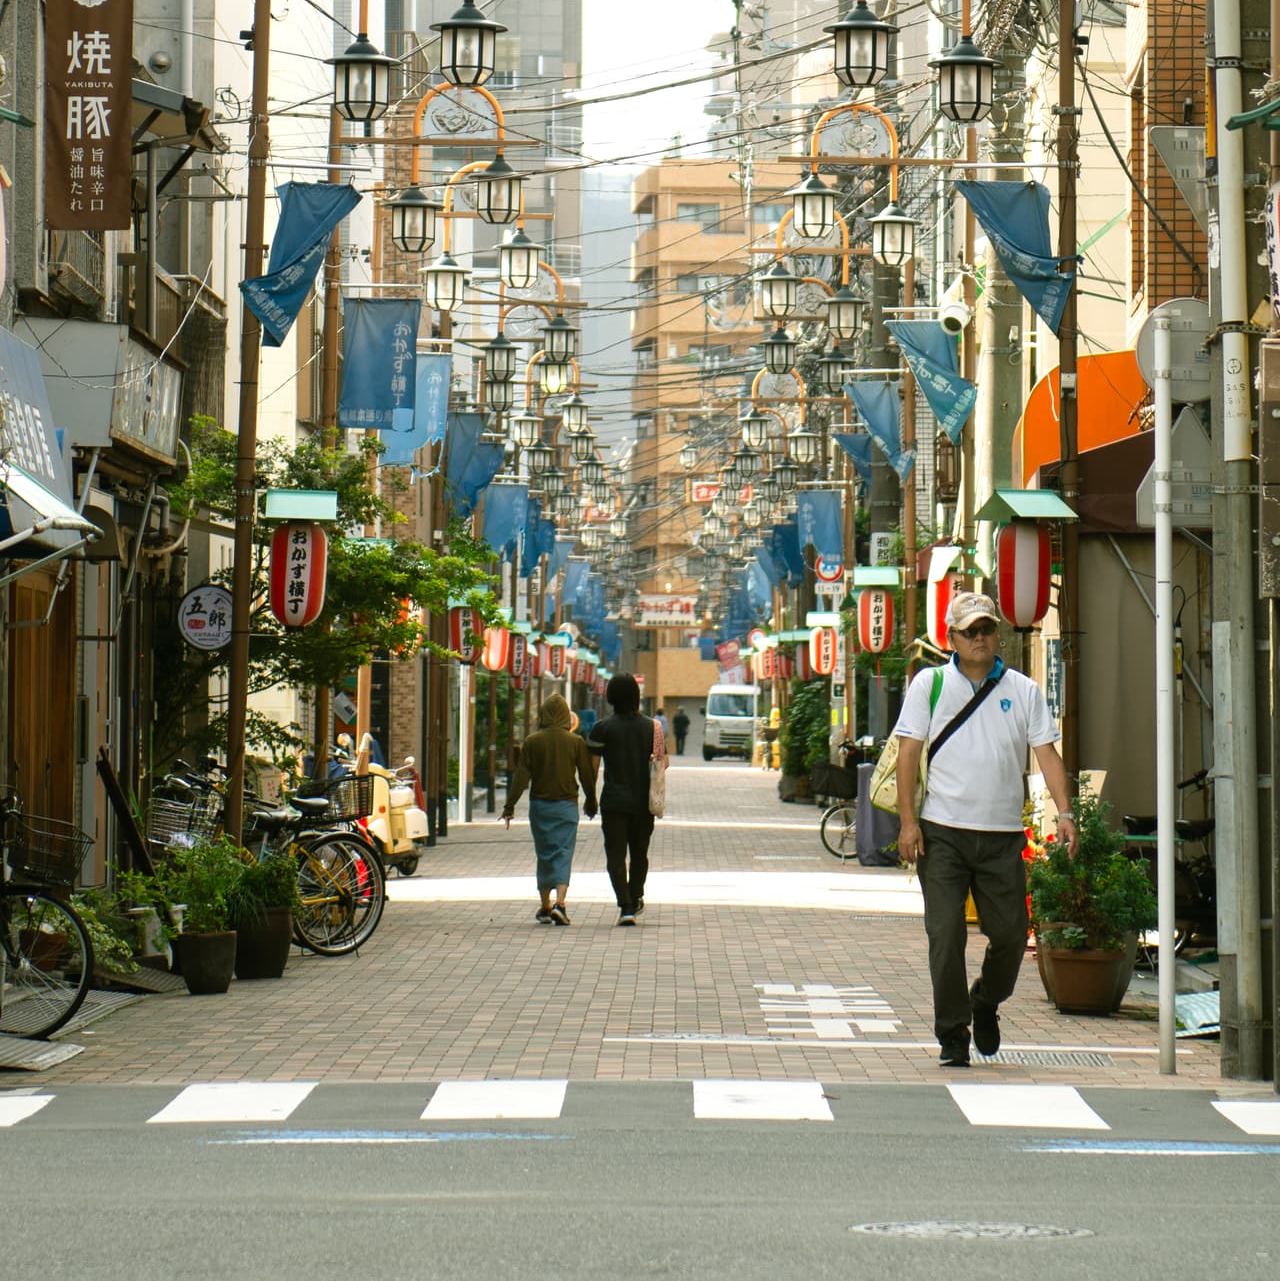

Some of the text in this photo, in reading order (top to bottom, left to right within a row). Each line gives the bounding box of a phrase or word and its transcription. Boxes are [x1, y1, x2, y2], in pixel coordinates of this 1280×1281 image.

[66, 30, 112, 75] 焼
[67, 96, 113, 139] 豚
[69, 147, 84, 211] 醤油たれ
[90, 147, 105, 211] 旨味辛口
[286, 529, 309, 612] おかず横丁
[872, 594, 883, 647] おかず横丁
